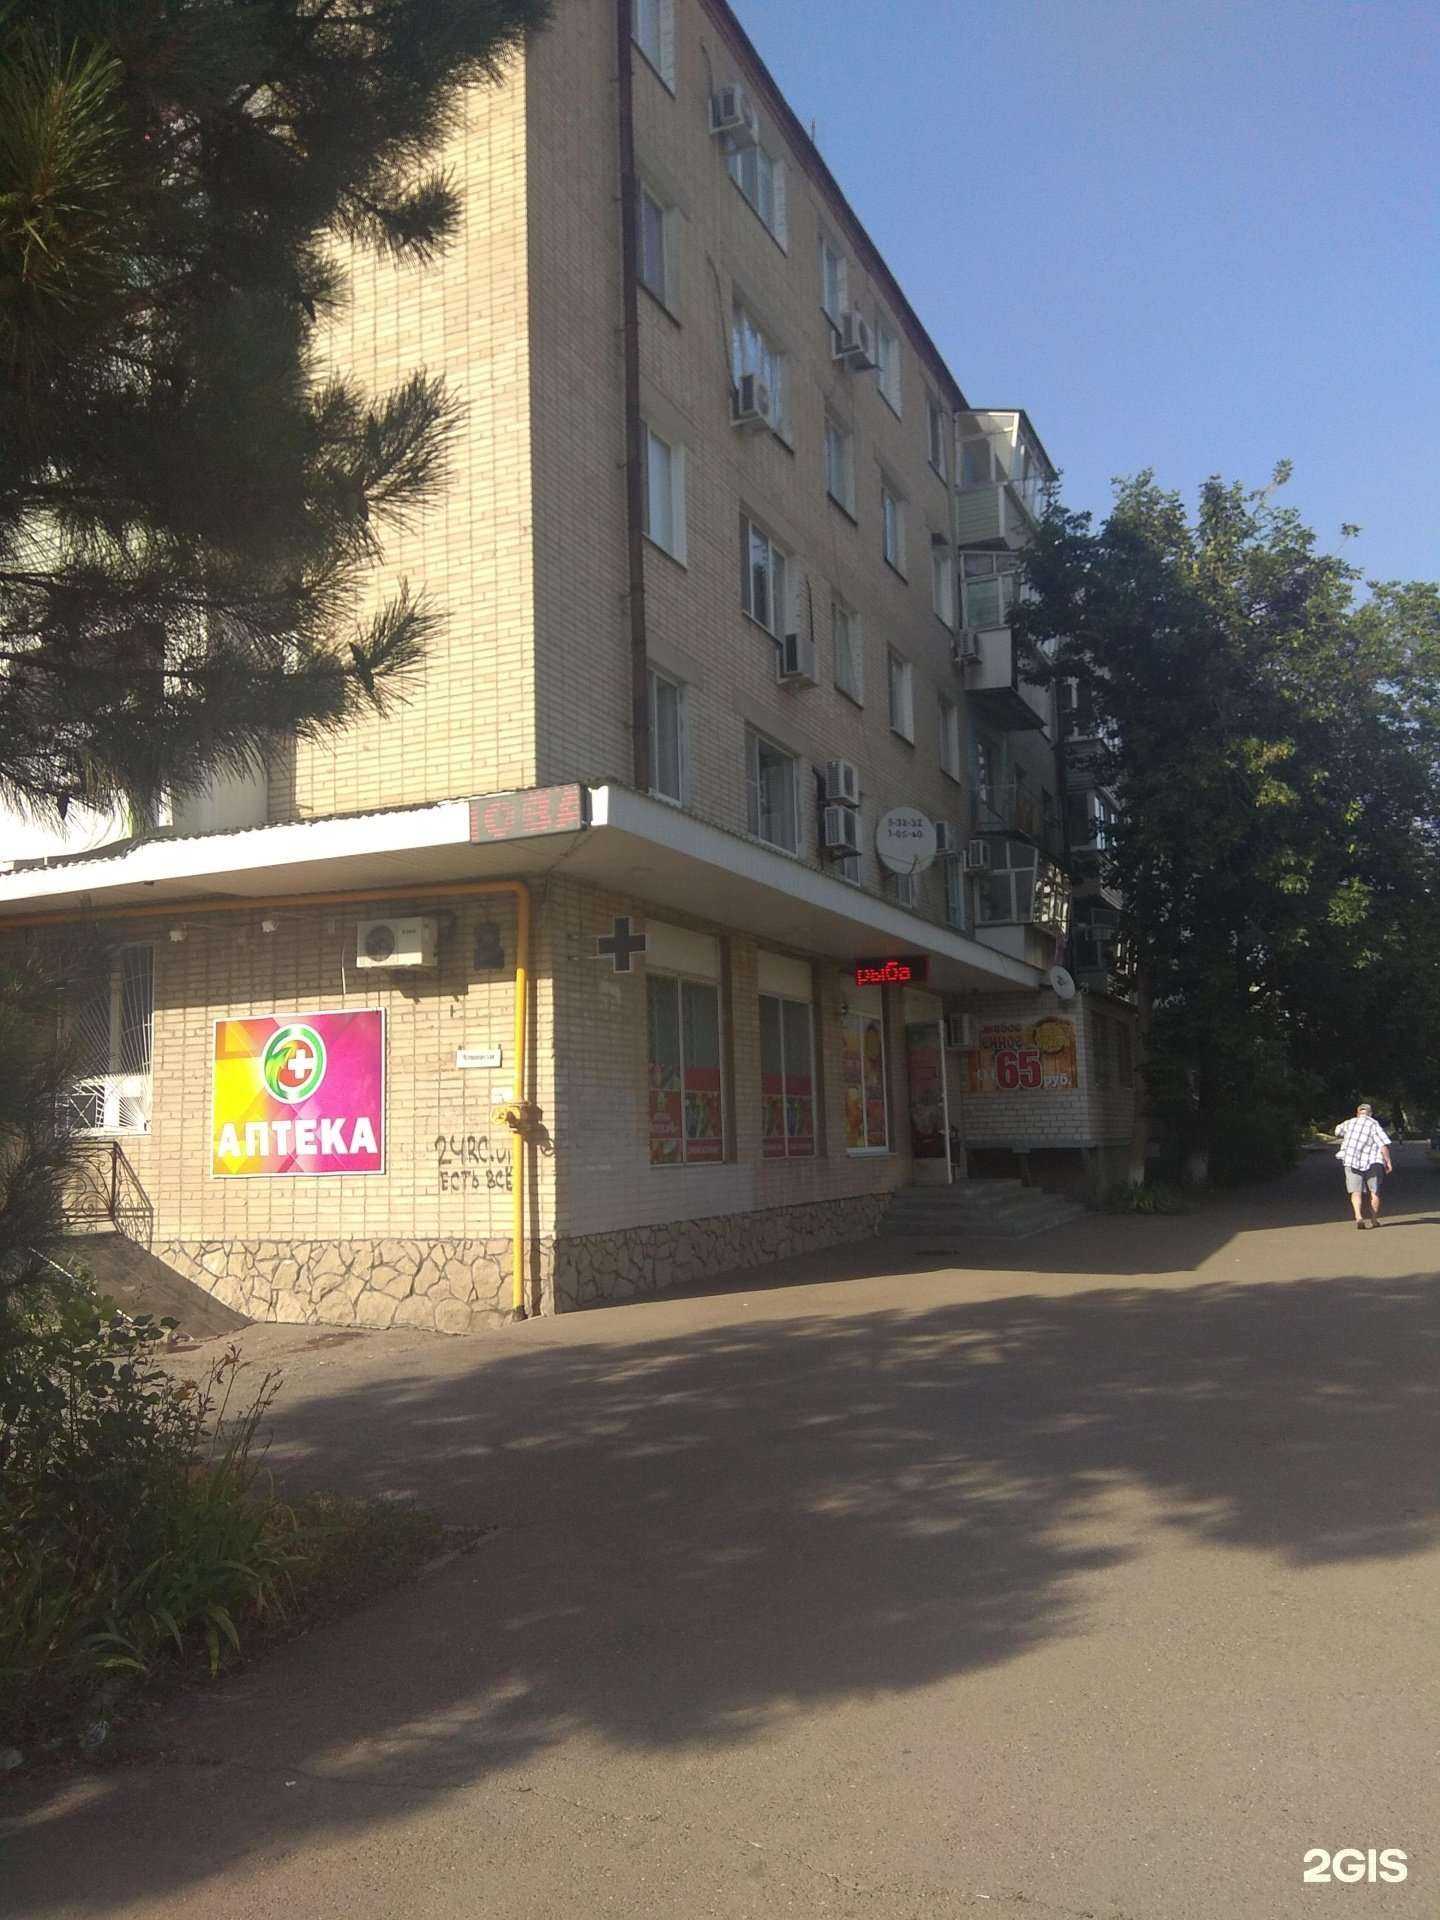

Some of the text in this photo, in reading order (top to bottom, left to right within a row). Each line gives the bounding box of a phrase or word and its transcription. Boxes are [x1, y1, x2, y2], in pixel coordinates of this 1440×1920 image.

[856, 961, 911, 985] рыба
[995, 1050, 1042, 1089] 65
[217, 1116, 378, 1158] АПТЕКА
[441, 1169, 479, 1192] ЕСТЬ
